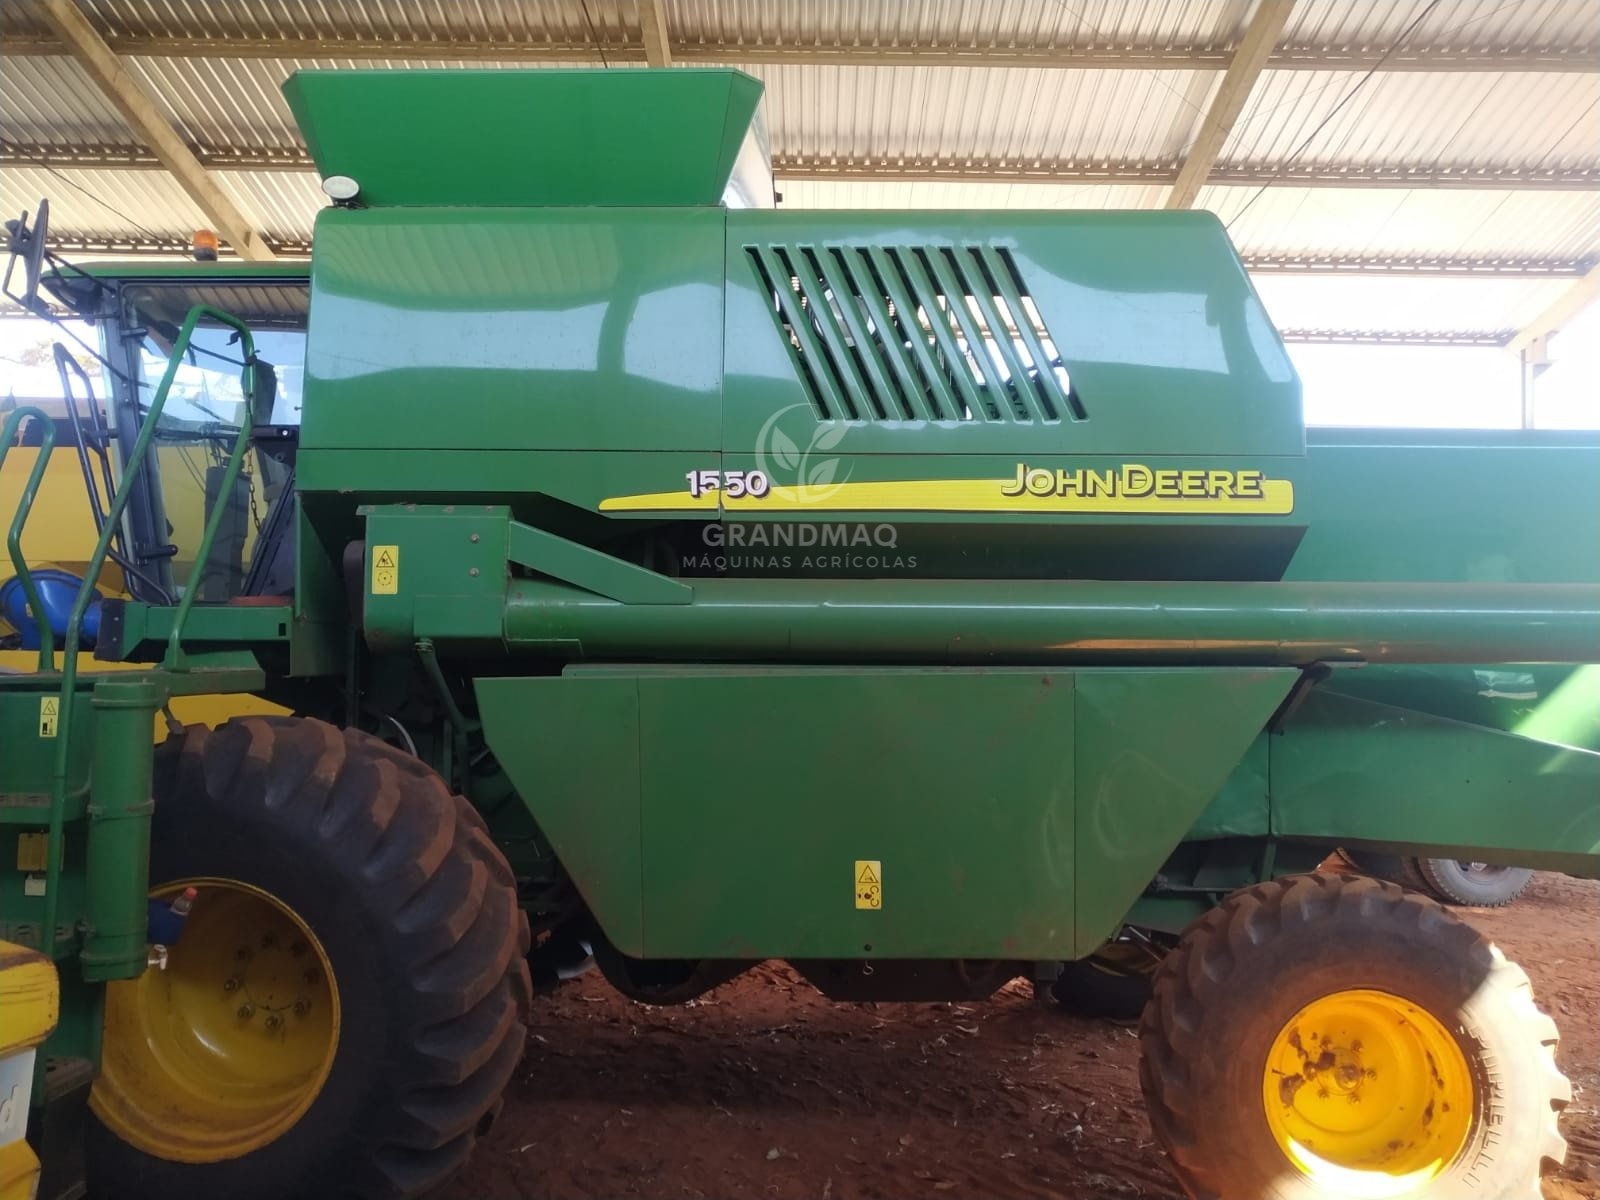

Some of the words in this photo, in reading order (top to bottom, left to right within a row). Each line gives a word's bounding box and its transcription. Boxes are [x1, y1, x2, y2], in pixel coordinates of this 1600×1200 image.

[686, 470, 769, 499] 1550
[1000, 463, 1116, 497] JOHN
[1121, 464, 1264, 497] DEERE
[1462, 1024, 1506, 1189] PIRELLI
